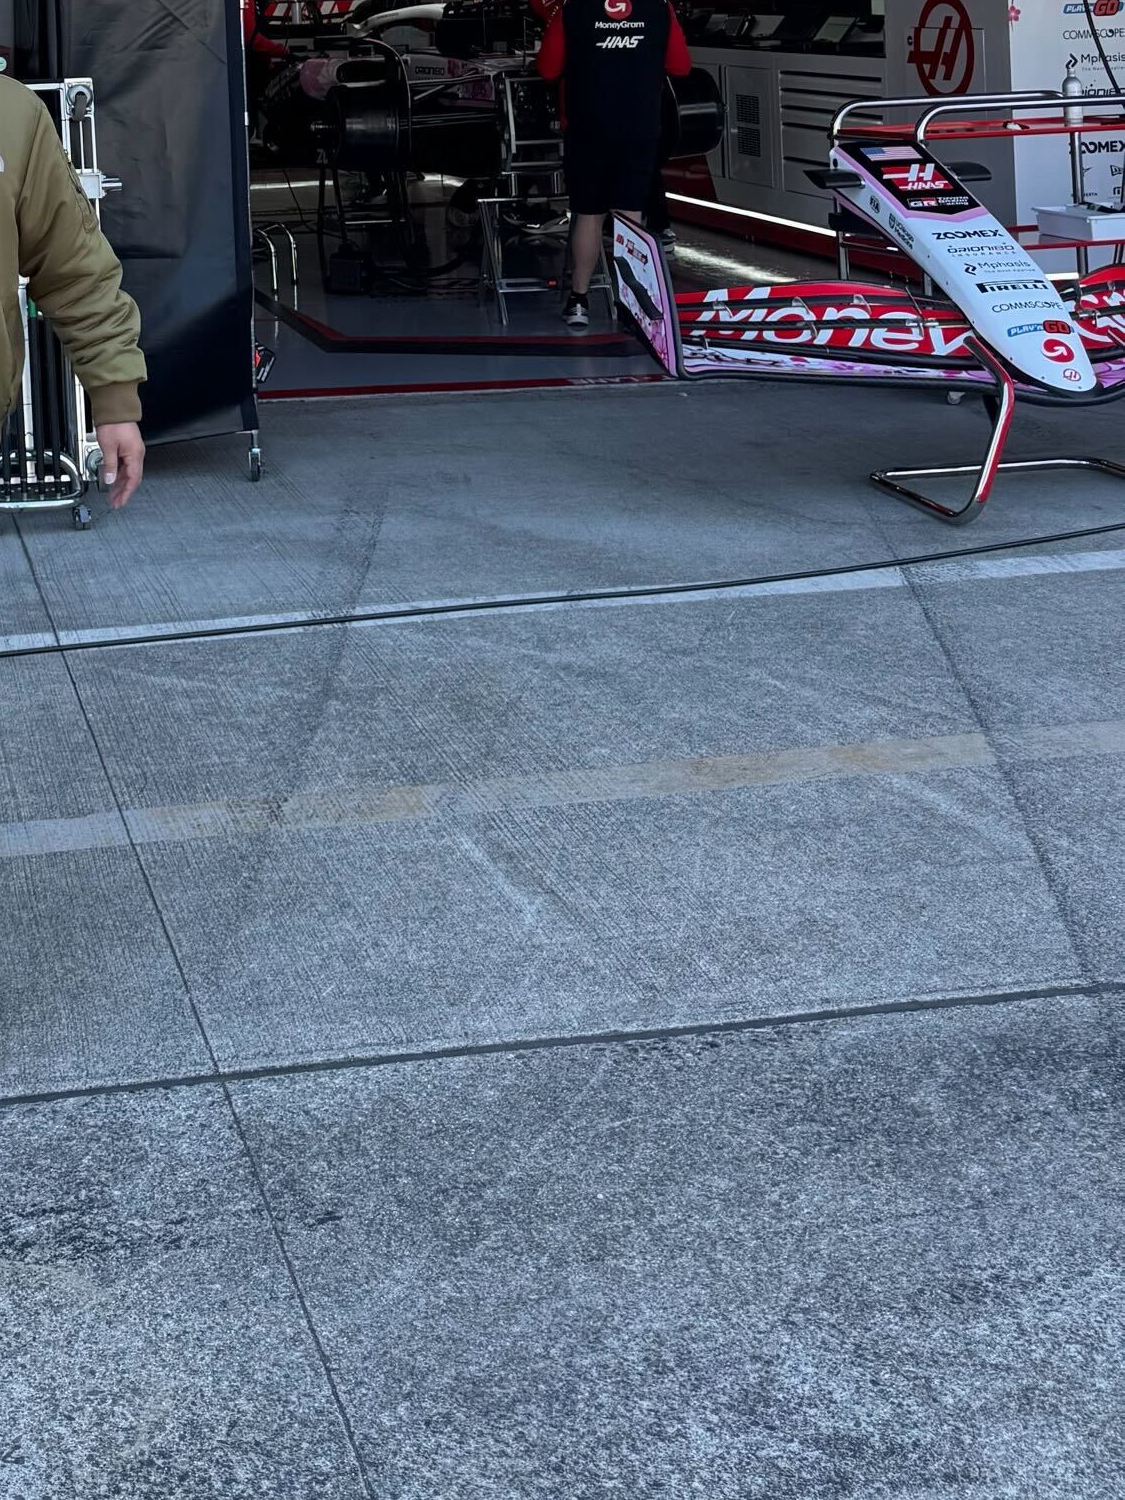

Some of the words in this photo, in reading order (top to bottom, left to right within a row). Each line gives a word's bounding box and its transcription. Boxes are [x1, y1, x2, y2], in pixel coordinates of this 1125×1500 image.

[595, 21, 644, 30] MoneyGram
[596, 35, 644, 48] HAAS
[899, 180, 949, 190] HAAS
[932, 229, 1004, 240] ZOOMEX
[978, 260, 1031, 269] Mphasis
[976, 280, 1049, 293] PIRELLI
[992, 300, 1064, 313] COMMSCOPE
